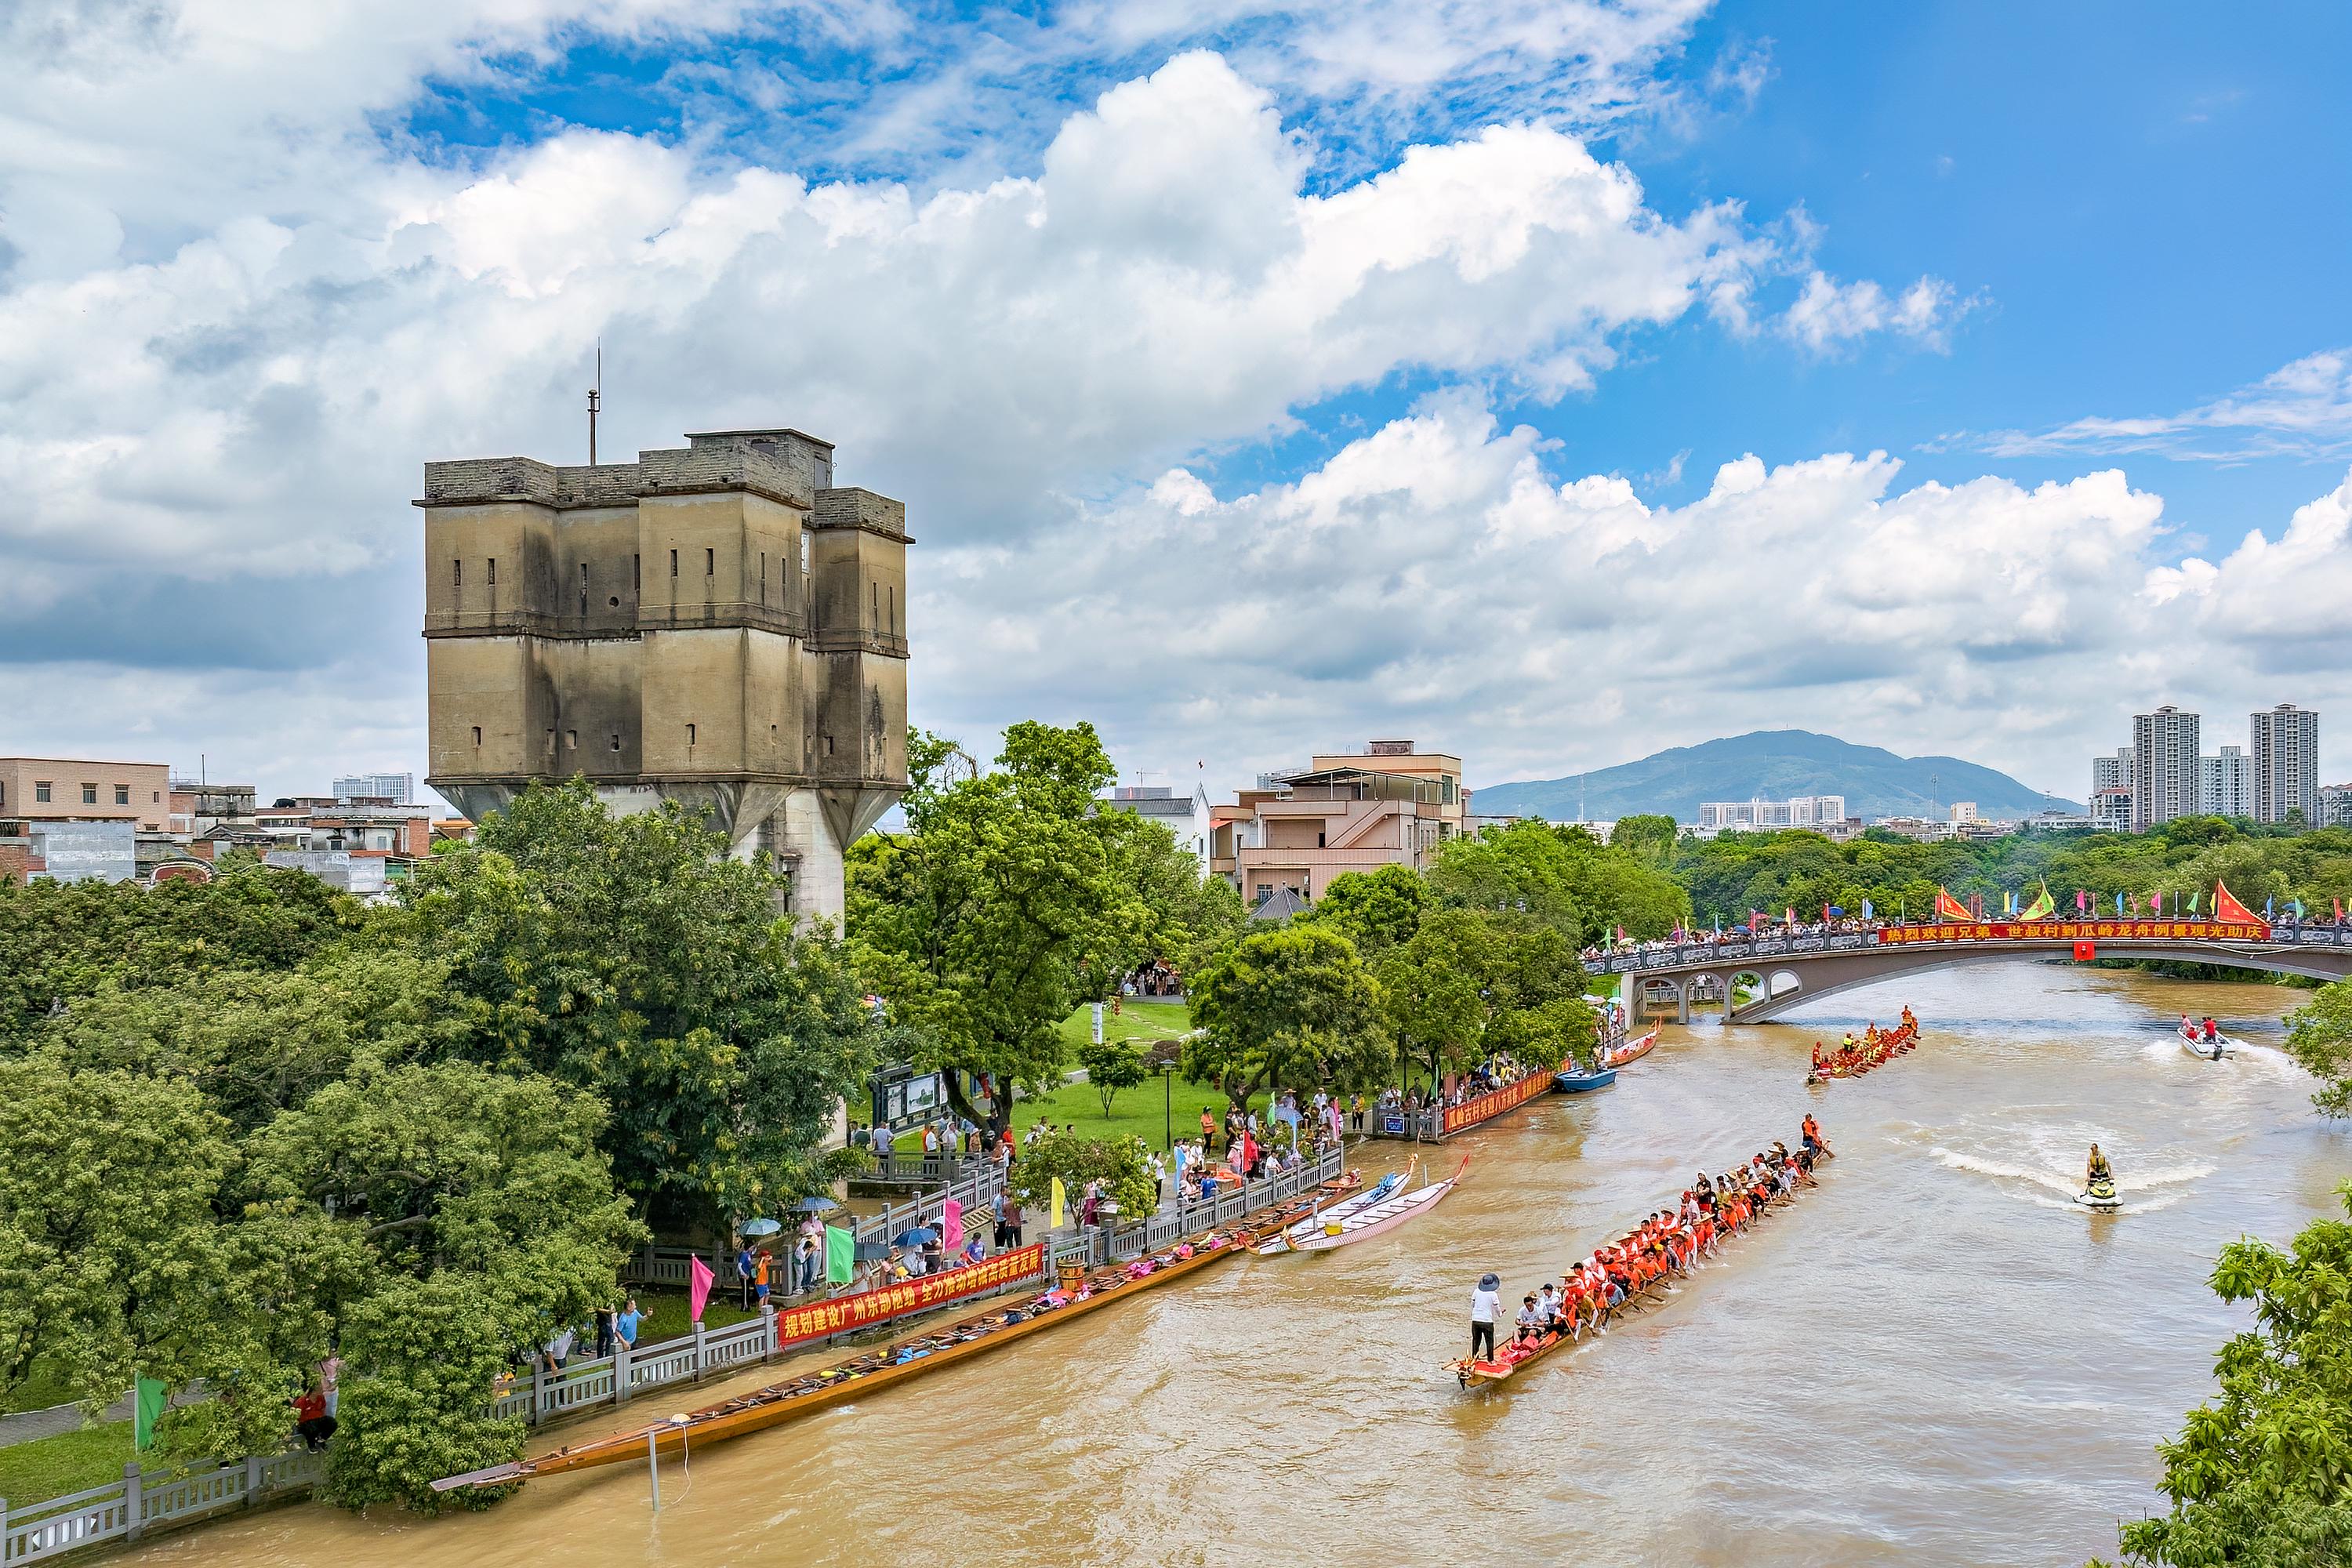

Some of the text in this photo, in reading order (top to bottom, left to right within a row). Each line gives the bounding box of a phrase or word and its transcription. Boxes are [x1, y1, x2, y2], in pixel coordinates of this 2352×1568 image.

[785, 1286, 916, 1338] 规划建设广州东部枢纽
